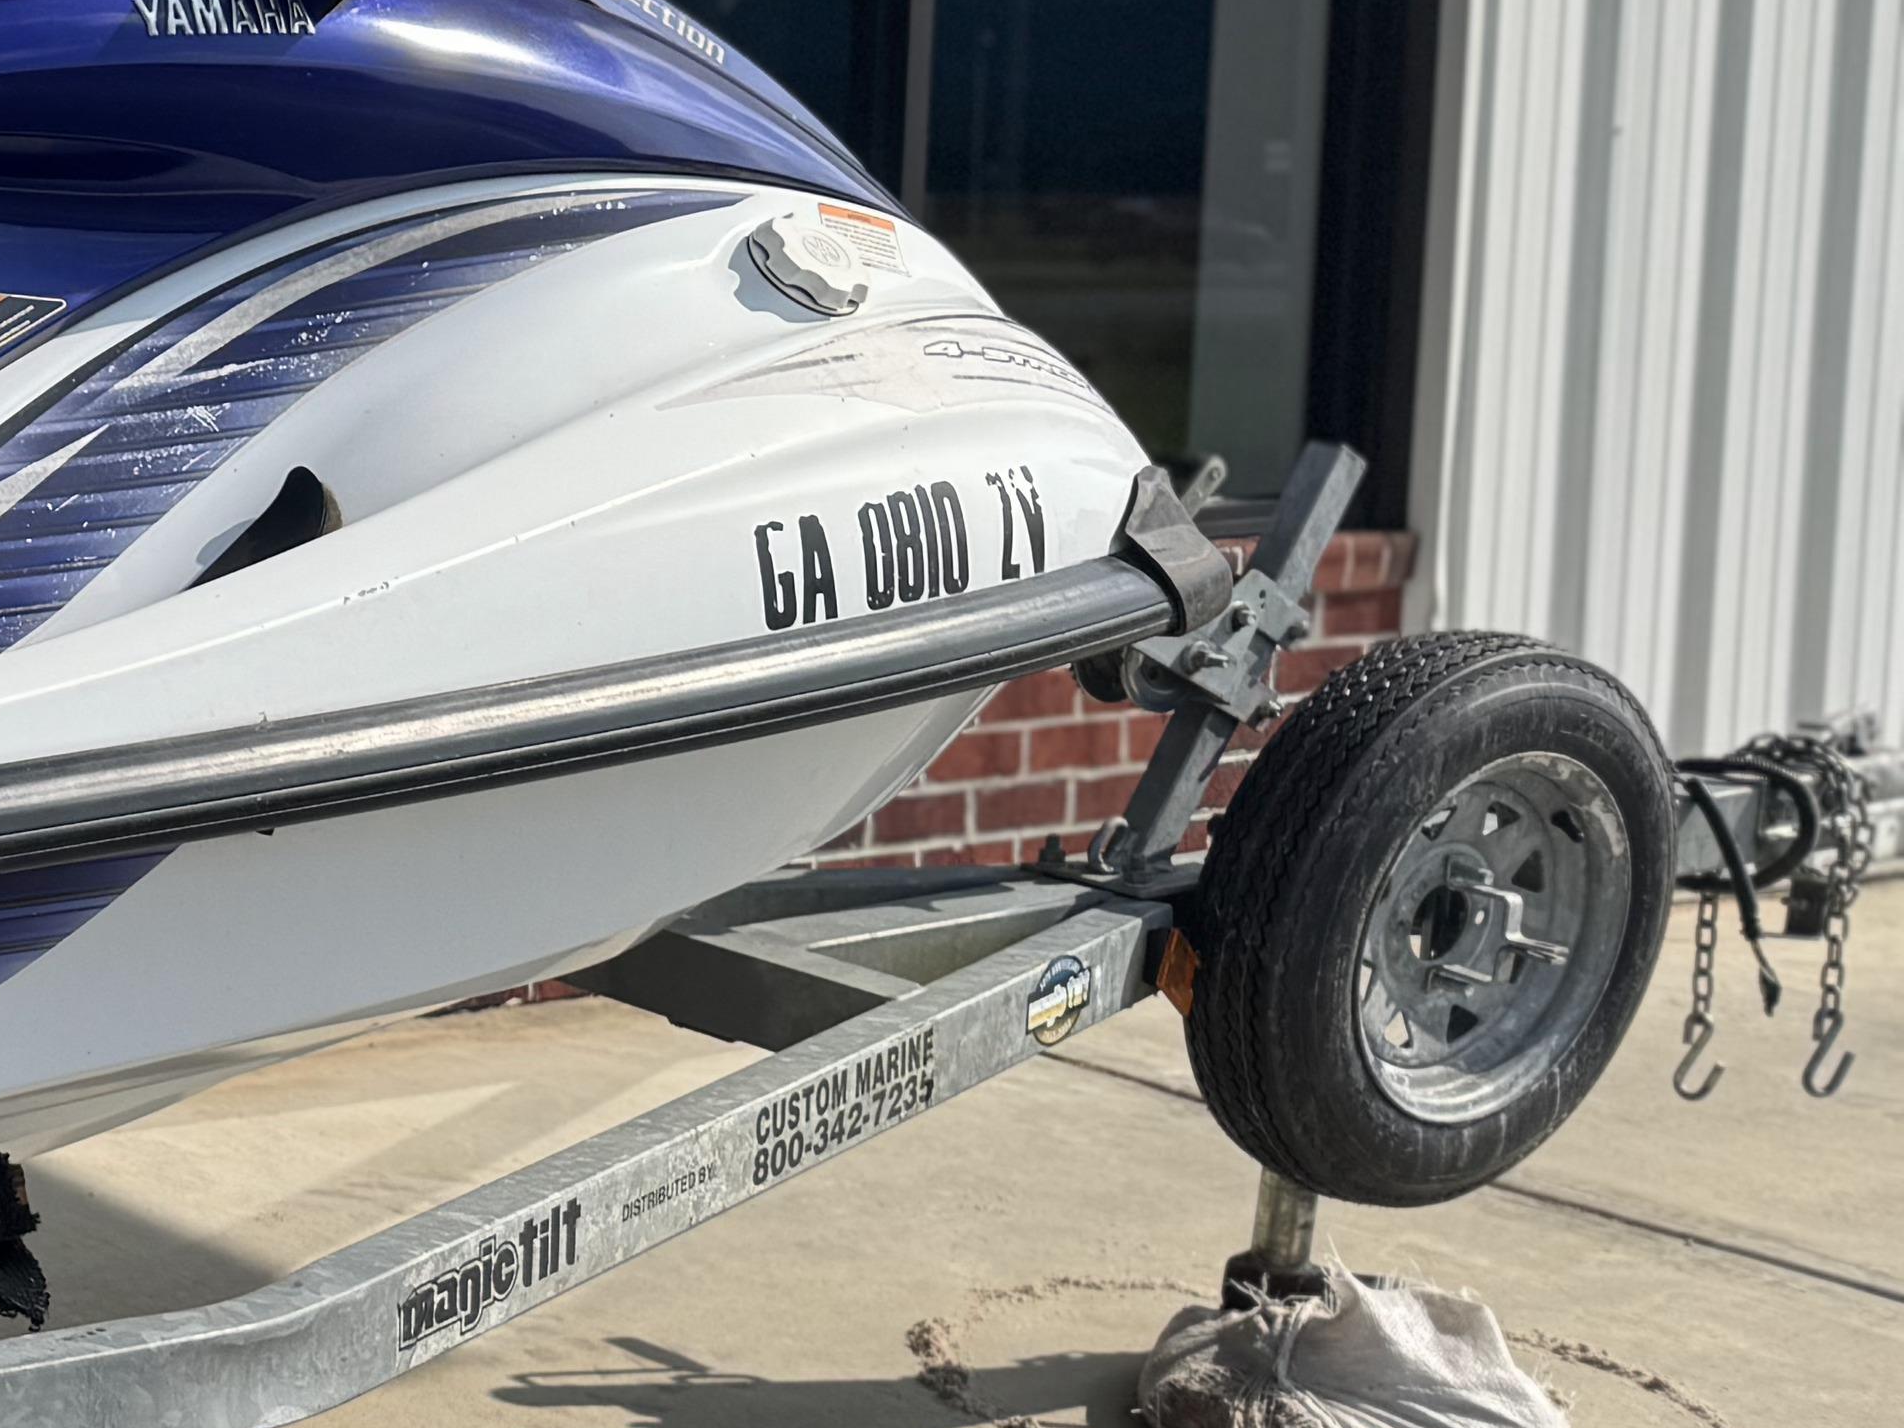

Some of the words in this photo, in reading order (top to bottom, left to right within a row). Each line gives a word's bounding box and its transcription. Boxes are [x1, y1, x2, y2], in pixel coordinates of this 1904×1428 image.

[753, 514, 839, 632] GA
[857, 480, 970, 612] 0810
[752, 1070, 935, 1186] 800-342-7235
[755, 1069, 848, 1146] CUSTOM
[855, 1025, 935, 1099] MARINE
[621, 1171, 697, 1223] DISTRIBUTED
